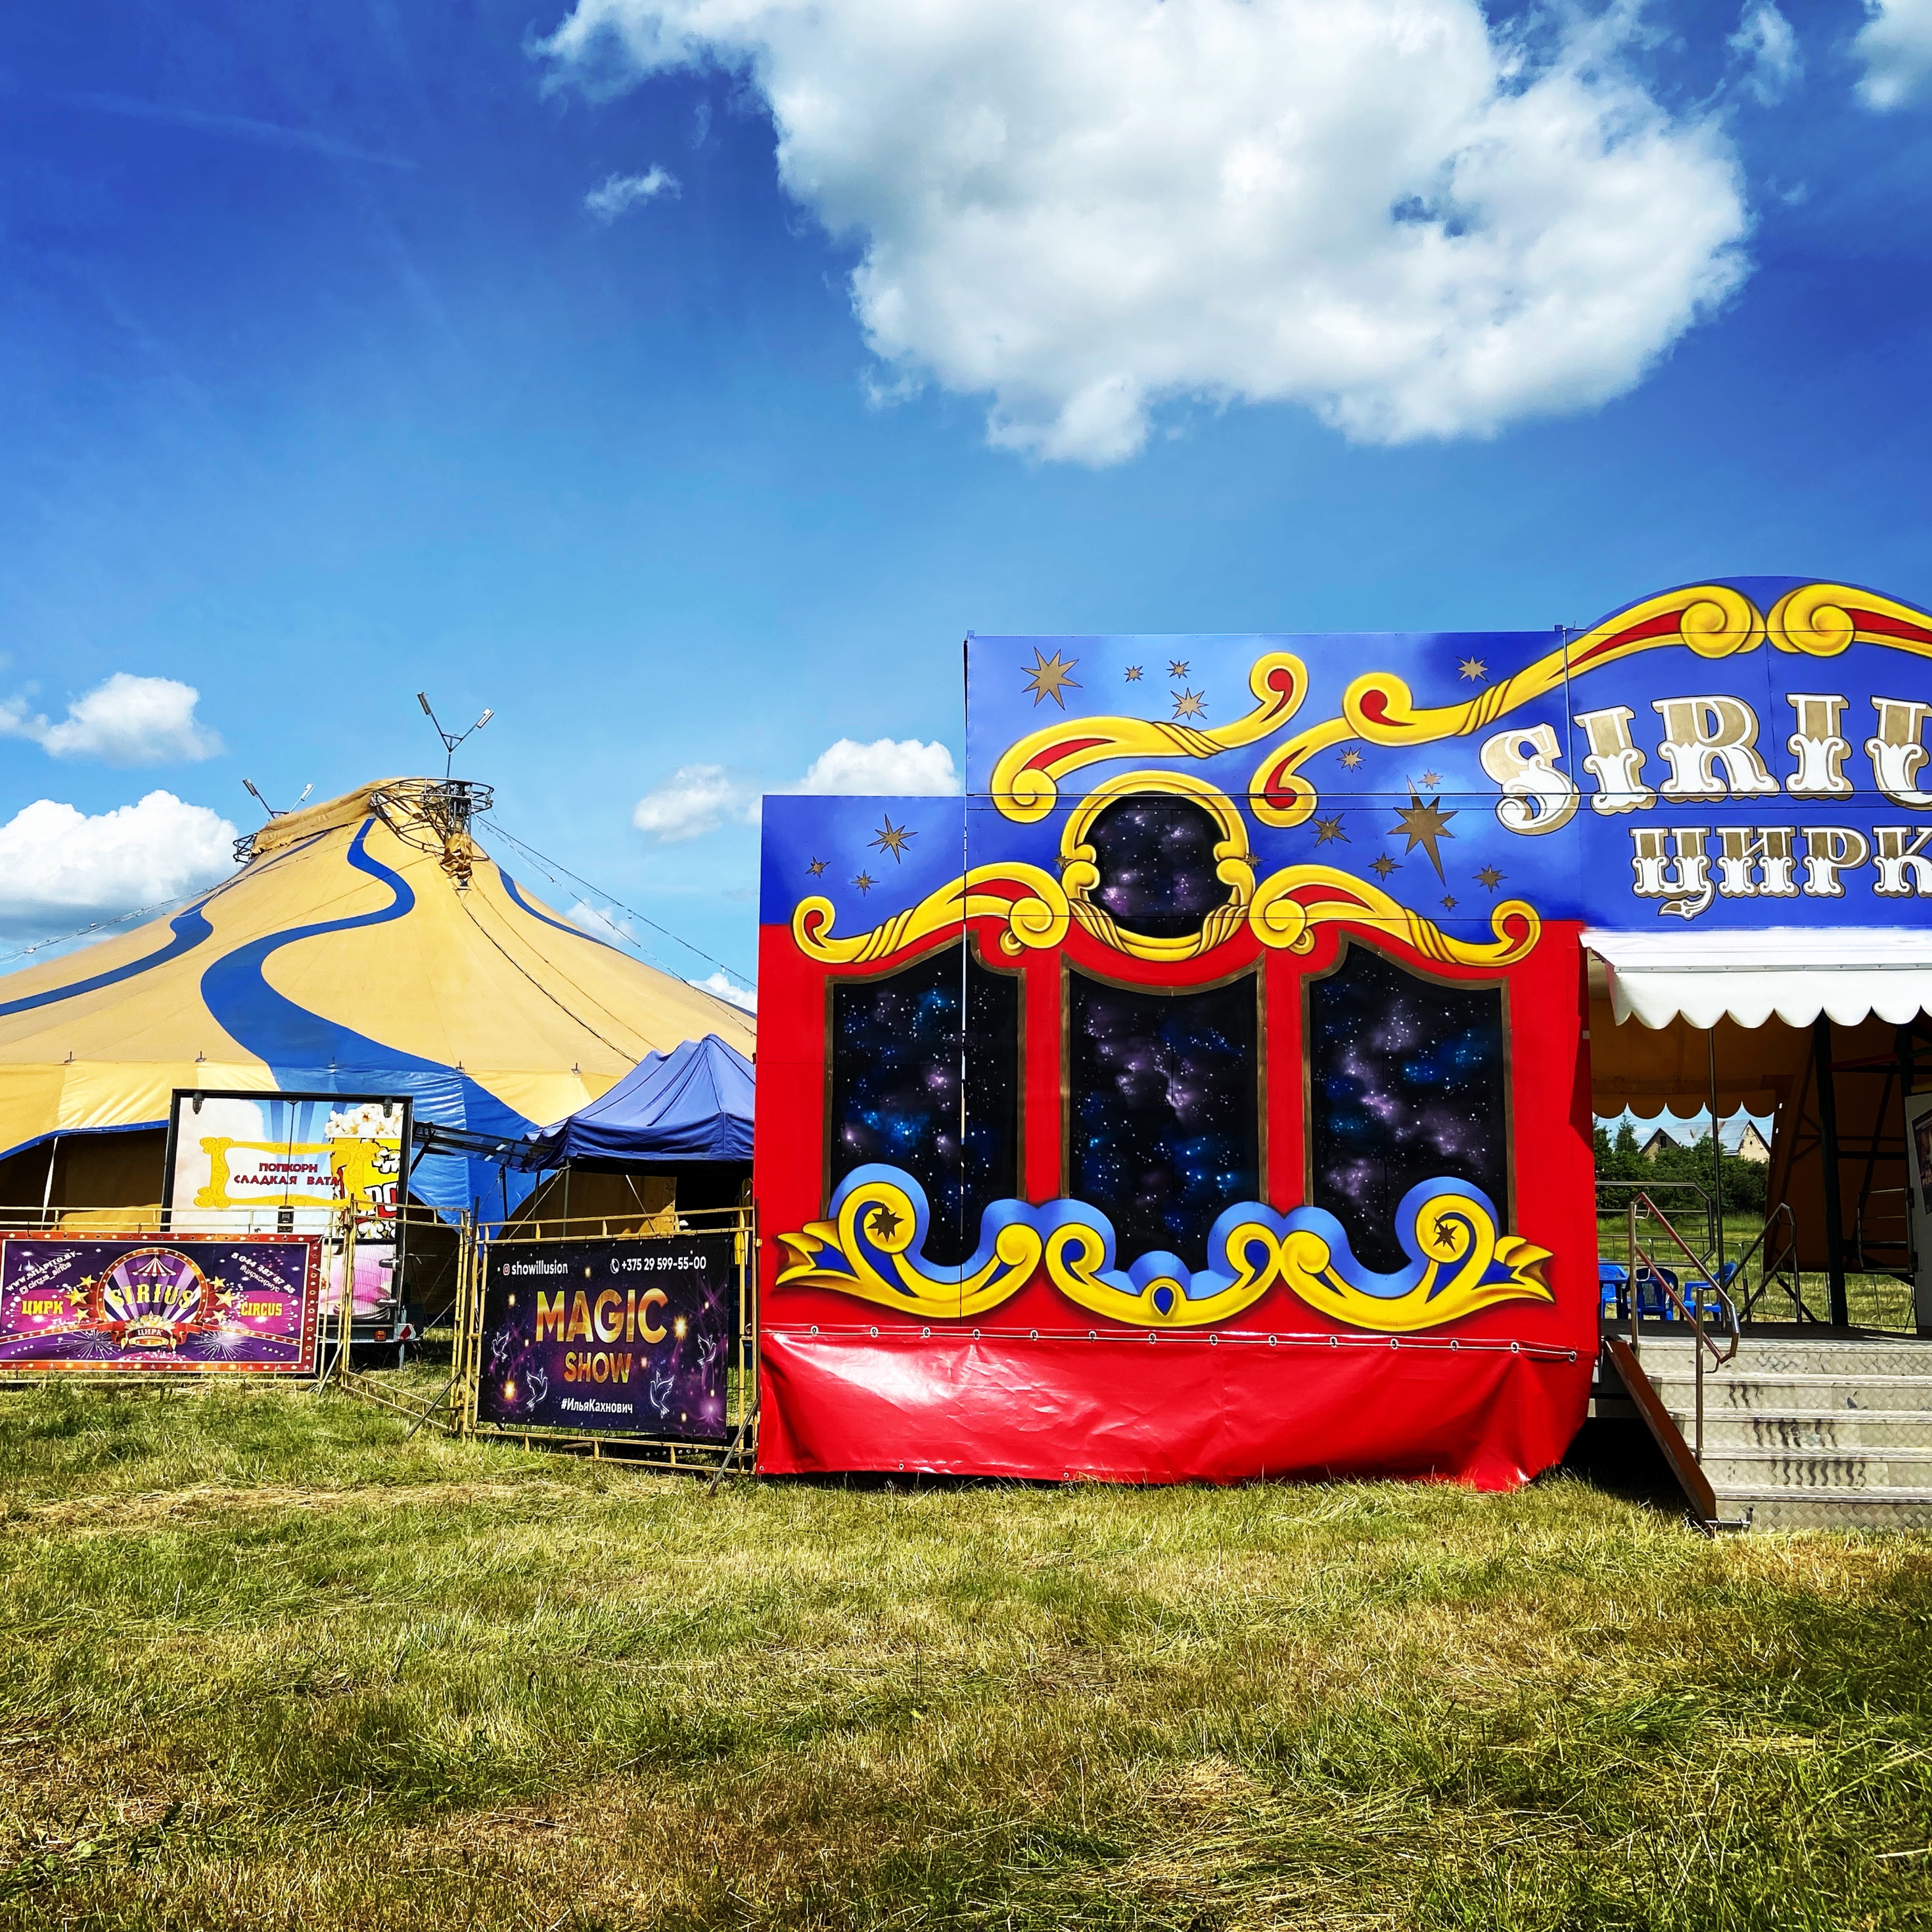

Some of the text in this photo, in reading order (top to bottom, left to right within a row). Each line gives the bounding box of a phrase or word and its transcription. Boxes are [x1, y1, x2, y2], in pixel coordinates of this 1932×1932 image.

[259, 1162, 318, 1173] ПОПКОРН
[234, 1175, 340, 1185] СЛАДКАЯ ВАТА
[239, 1255, 257, 1267] 044
[511, 1259, 568, 1275] showillusion
[622, 1256, 706, 1271] +375 29 599-55-00
[240, 1264, 280, 1292] #цирксириус
[109, 1283, 196, 1309] SIRIUS
[22, 1300, 63, 1315] ЦИРК
[241, 1301, 282, 1316] CIRCUS
[536, 1288, 669, 1344] MAGIC
[564, 1351, 632, 1384] SHOW
[561, 1398, 632, 1413] #ИльяКахнович
